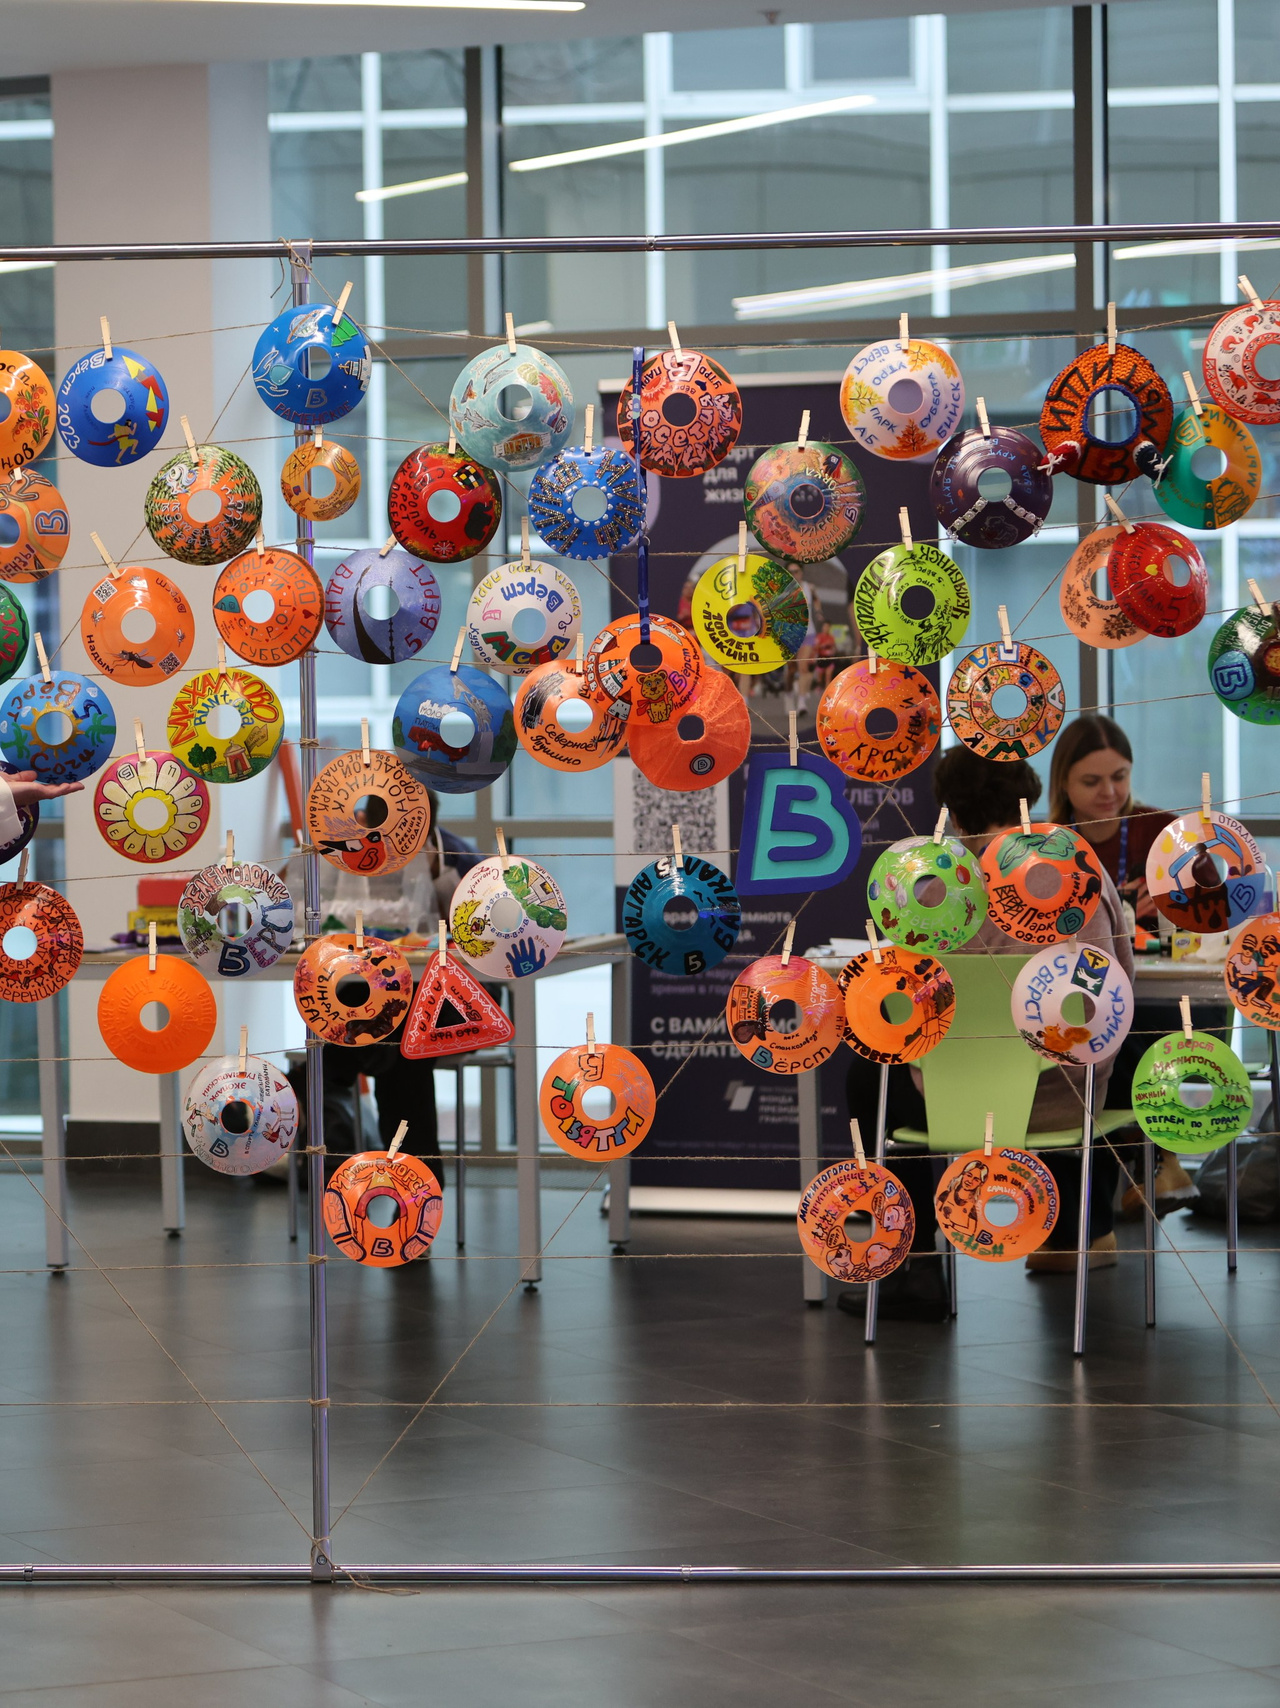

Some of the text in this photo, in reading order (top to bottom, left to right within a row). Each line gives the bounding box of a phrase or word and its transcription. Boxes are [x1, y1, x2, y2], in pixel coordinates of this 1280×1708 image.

[57, 403, 81, 450] 2023
[273, 400, 353, 426] РАМЕНСКОЕ
[870, 407, 896, 433] ПАРК
[936, 381, 961, 439] БИЙСК
[325, 562, 354, 634] ВДНХ
[86, 634, 114, 674] Надым
[240, 624, 312, 662] СУББОТА
[404, 632, 423, 653] 5
[332, 775, 409, 813] НОГИНСК
[1218, 814, 1262, 864] ОТРАДНЫЙ
[624, 872, 671, 970] АНГАРСК
[1015, 930, 1056, 944] 09:00
[1052, 955, 1069, 977] 5
[300, 994, 328, 1032] БАМ
[363, 1001, 377, 1018] 5
[650, 1016, 664, 1034] С
[669, 1016, 727, 1034] ВАМИ
[1089, 985, 1125, 1054] БИЙСК
[430, 1031, 453, 1042] УФА
[1164, 1042, 1173, 1054] 5
[1210, 1115, 1241, 1127] ГОРАМ
[800, 1162, 858, 1223] МАГНИТОГОРСК
[809, 1171, 866, 1220] ПРИТЯЖЕНИЕ
[1000, 1147, 1058, 1231] МАГНИТОГОРСК
